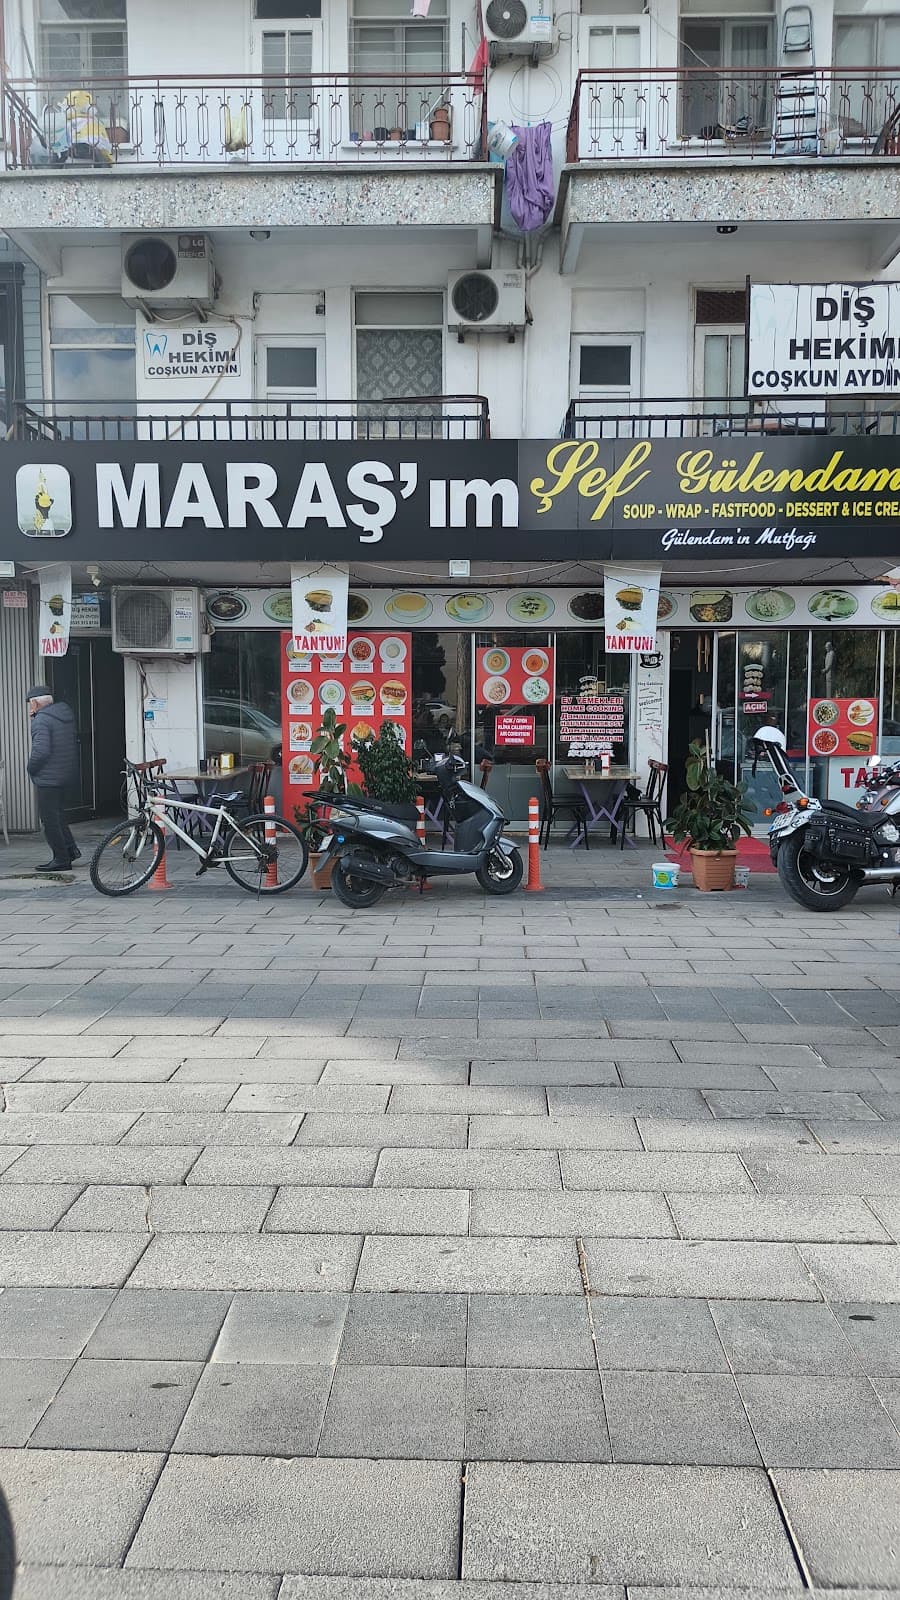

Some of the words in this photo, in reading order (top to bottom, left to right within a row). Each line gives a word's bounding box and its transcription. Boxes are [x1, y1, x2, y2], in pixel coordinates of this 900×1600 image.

[815, 290, 875, 328] DİŞ
[182, 330, 217, 348] DİŞ
[789, 332, 900, 360] HEKİM
[168, 349, 236, 363] HEKİMİ
[148, 365, 198, 376] COŞKUN
[201, 364, 238, 374] AYDIN
[751, 369, 838, 392] COŞKUN
[529, 441, 652, 521] Şef
[676, 449, 900, 494] Gülendam
[623, 504, 655, 519] SOUP
[665, 503, 702, 519] WRAP
[711, 502, 776, 518] FASTFOOD
[786, 502, 839, 517] DESSERT
[841, 501, 850, 517] &
[852, 501, 873, 517] ICE
[874, 501, 900, 517] CRE
[754, 527, 817, 550] Mutfağı
[561, 697, 573, 705] EV
